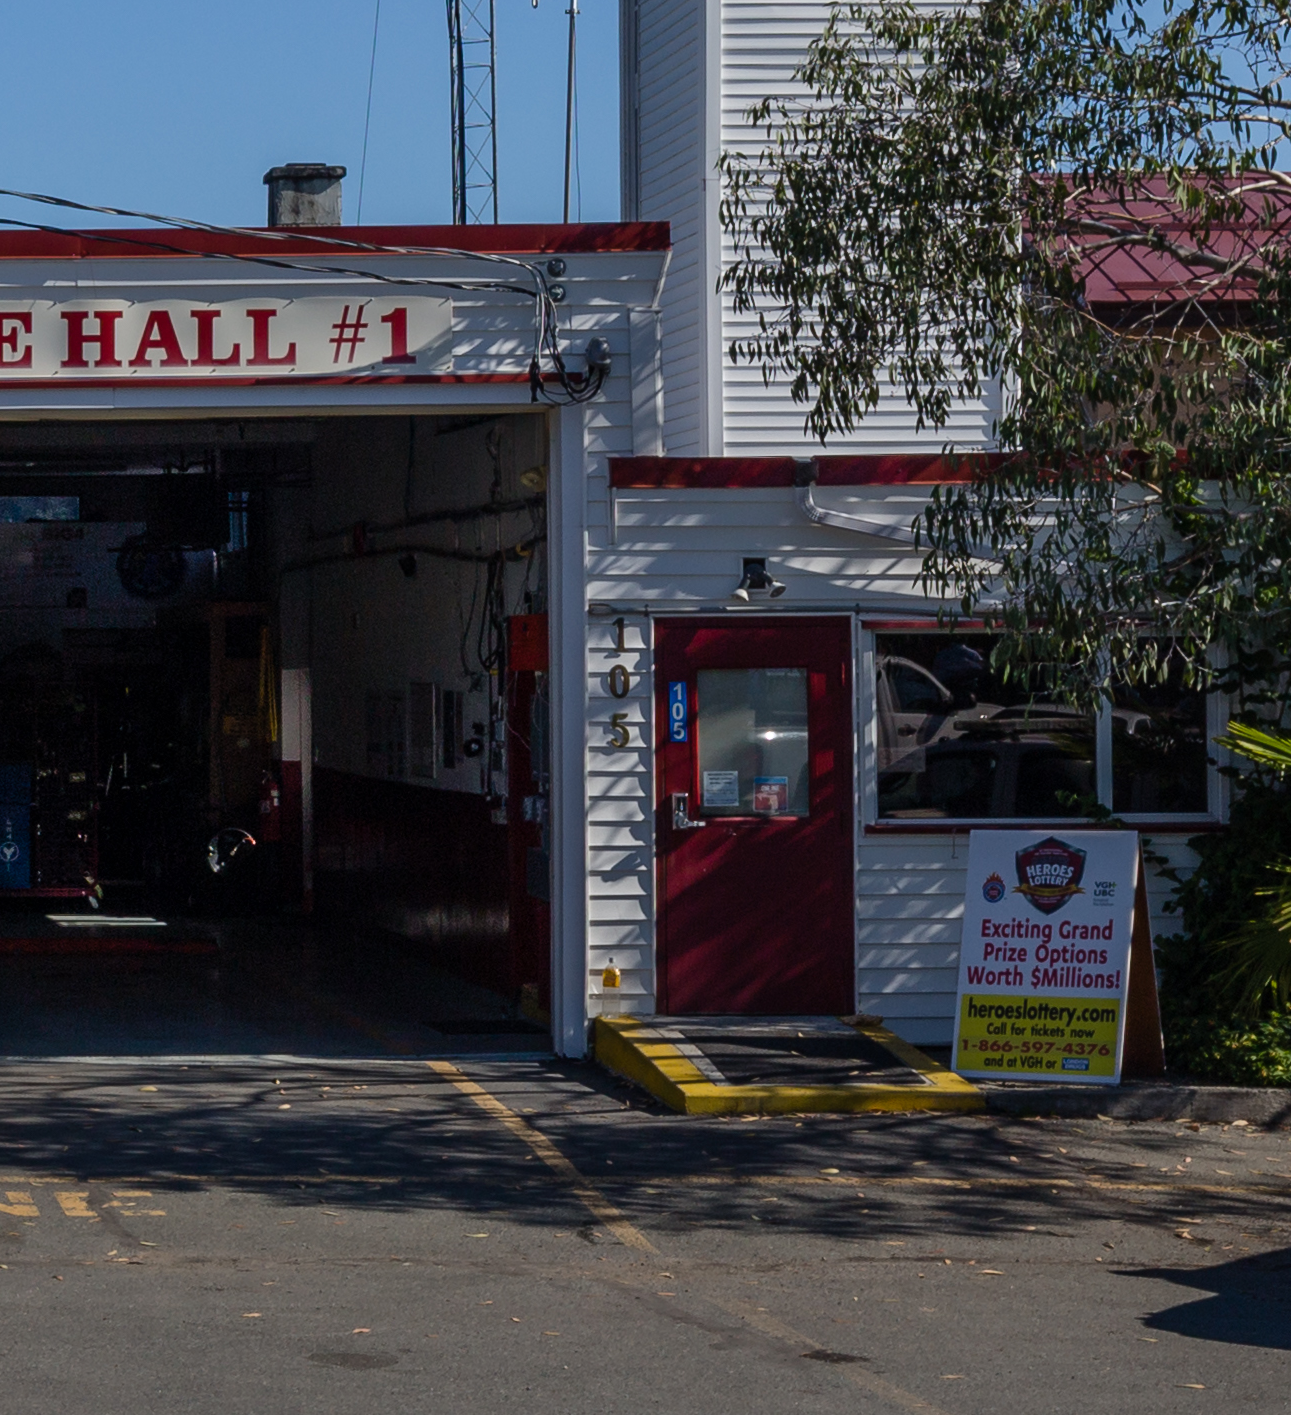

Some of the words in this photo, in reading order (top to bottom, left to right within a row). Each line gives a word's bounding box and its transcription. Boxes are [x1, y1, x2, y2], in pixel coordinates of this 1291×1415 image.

[60, 308, 297, 368] HALL
[328, 304, 418, 366] #1
[607, 616, 631, 749] 105
[671, 683, 685, 740] 105
[1026, 863, 1075, 878] HEROES
[1029, 875, 1070, 887] LOTTERY
[1093, 889, 1116, 897] UBC
[981, 918, 1053, 945] Exciting
[1058, 919, 1114, 941] Grand
[983, 942, 1028, 963] Prize
[1035, 943, 1108, 968] Options
[967, 966, 1024, 987] Worth
[1031, 967, 1121, 990] $Millions!
[968, 996, 1116, 1028] heroeslottery.com
[986, 1022, 1007, 1036] Call
[1011, 1023, 1026, 1036] for
[1030, 1024, 1065, 1038] tickets
[1070, 1027, 1095, 1039] now
[962, 1039, 1111, 1057] 1-866-597-4376
[983, 1055, 1004, 1069] and
[1007, 1057, 1018, 1068] at
[1020, 1056, 1044, 1069] VGH
[1045, 1060, 1057, 1069] or
